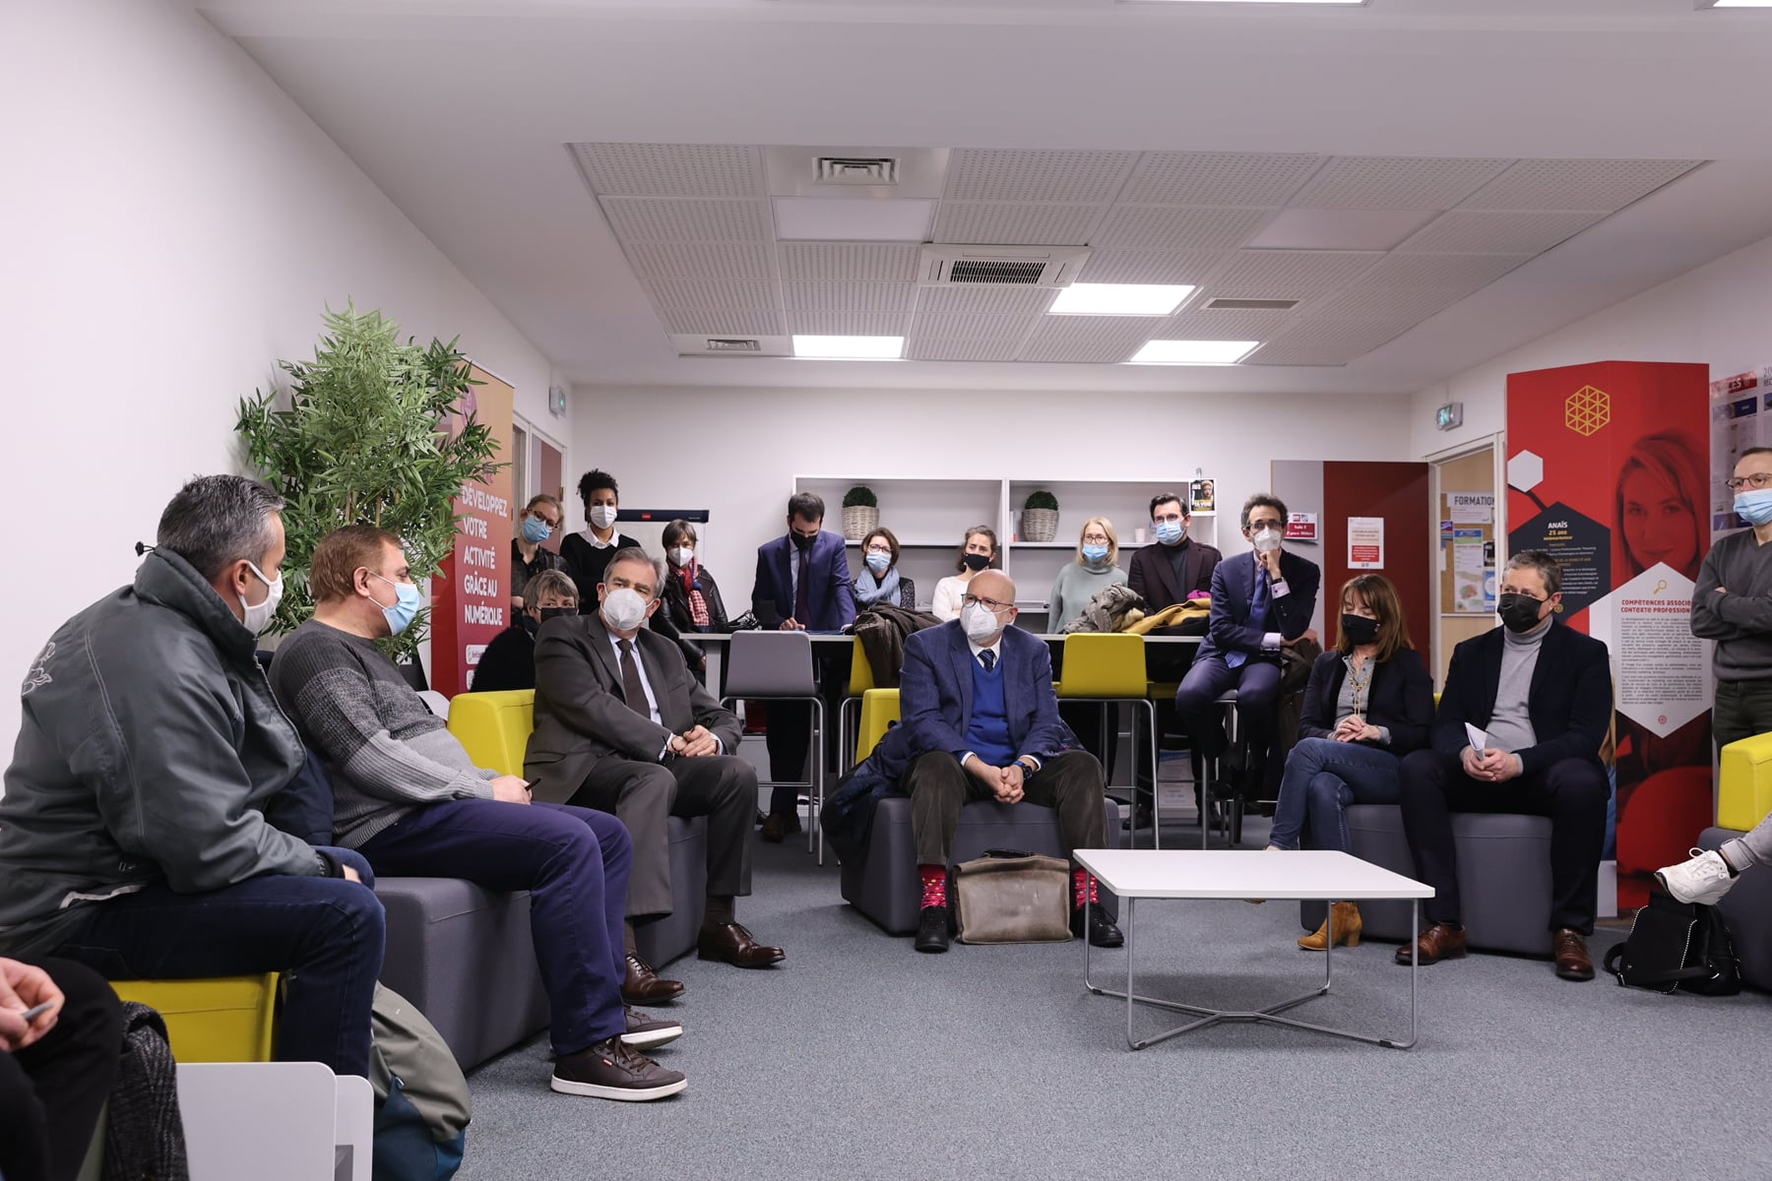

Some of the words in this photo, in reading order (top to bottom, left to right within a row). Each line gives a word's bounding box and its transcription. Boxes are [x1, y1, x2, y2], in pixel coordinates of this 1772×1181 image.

[462, 482, 507, 518] DÉVELOPPEZ
[463, 516, 488, 540] VOTRE
[1548, 521, 1568, 529] ANAÏS
[464, 546, 496, 569] ACTIVITÉ
[464, 570, 487, 596] GRÂCE
[488, 579, 498, 597] AU
[464, 601, 503, 626] NUMÉRIQUE
